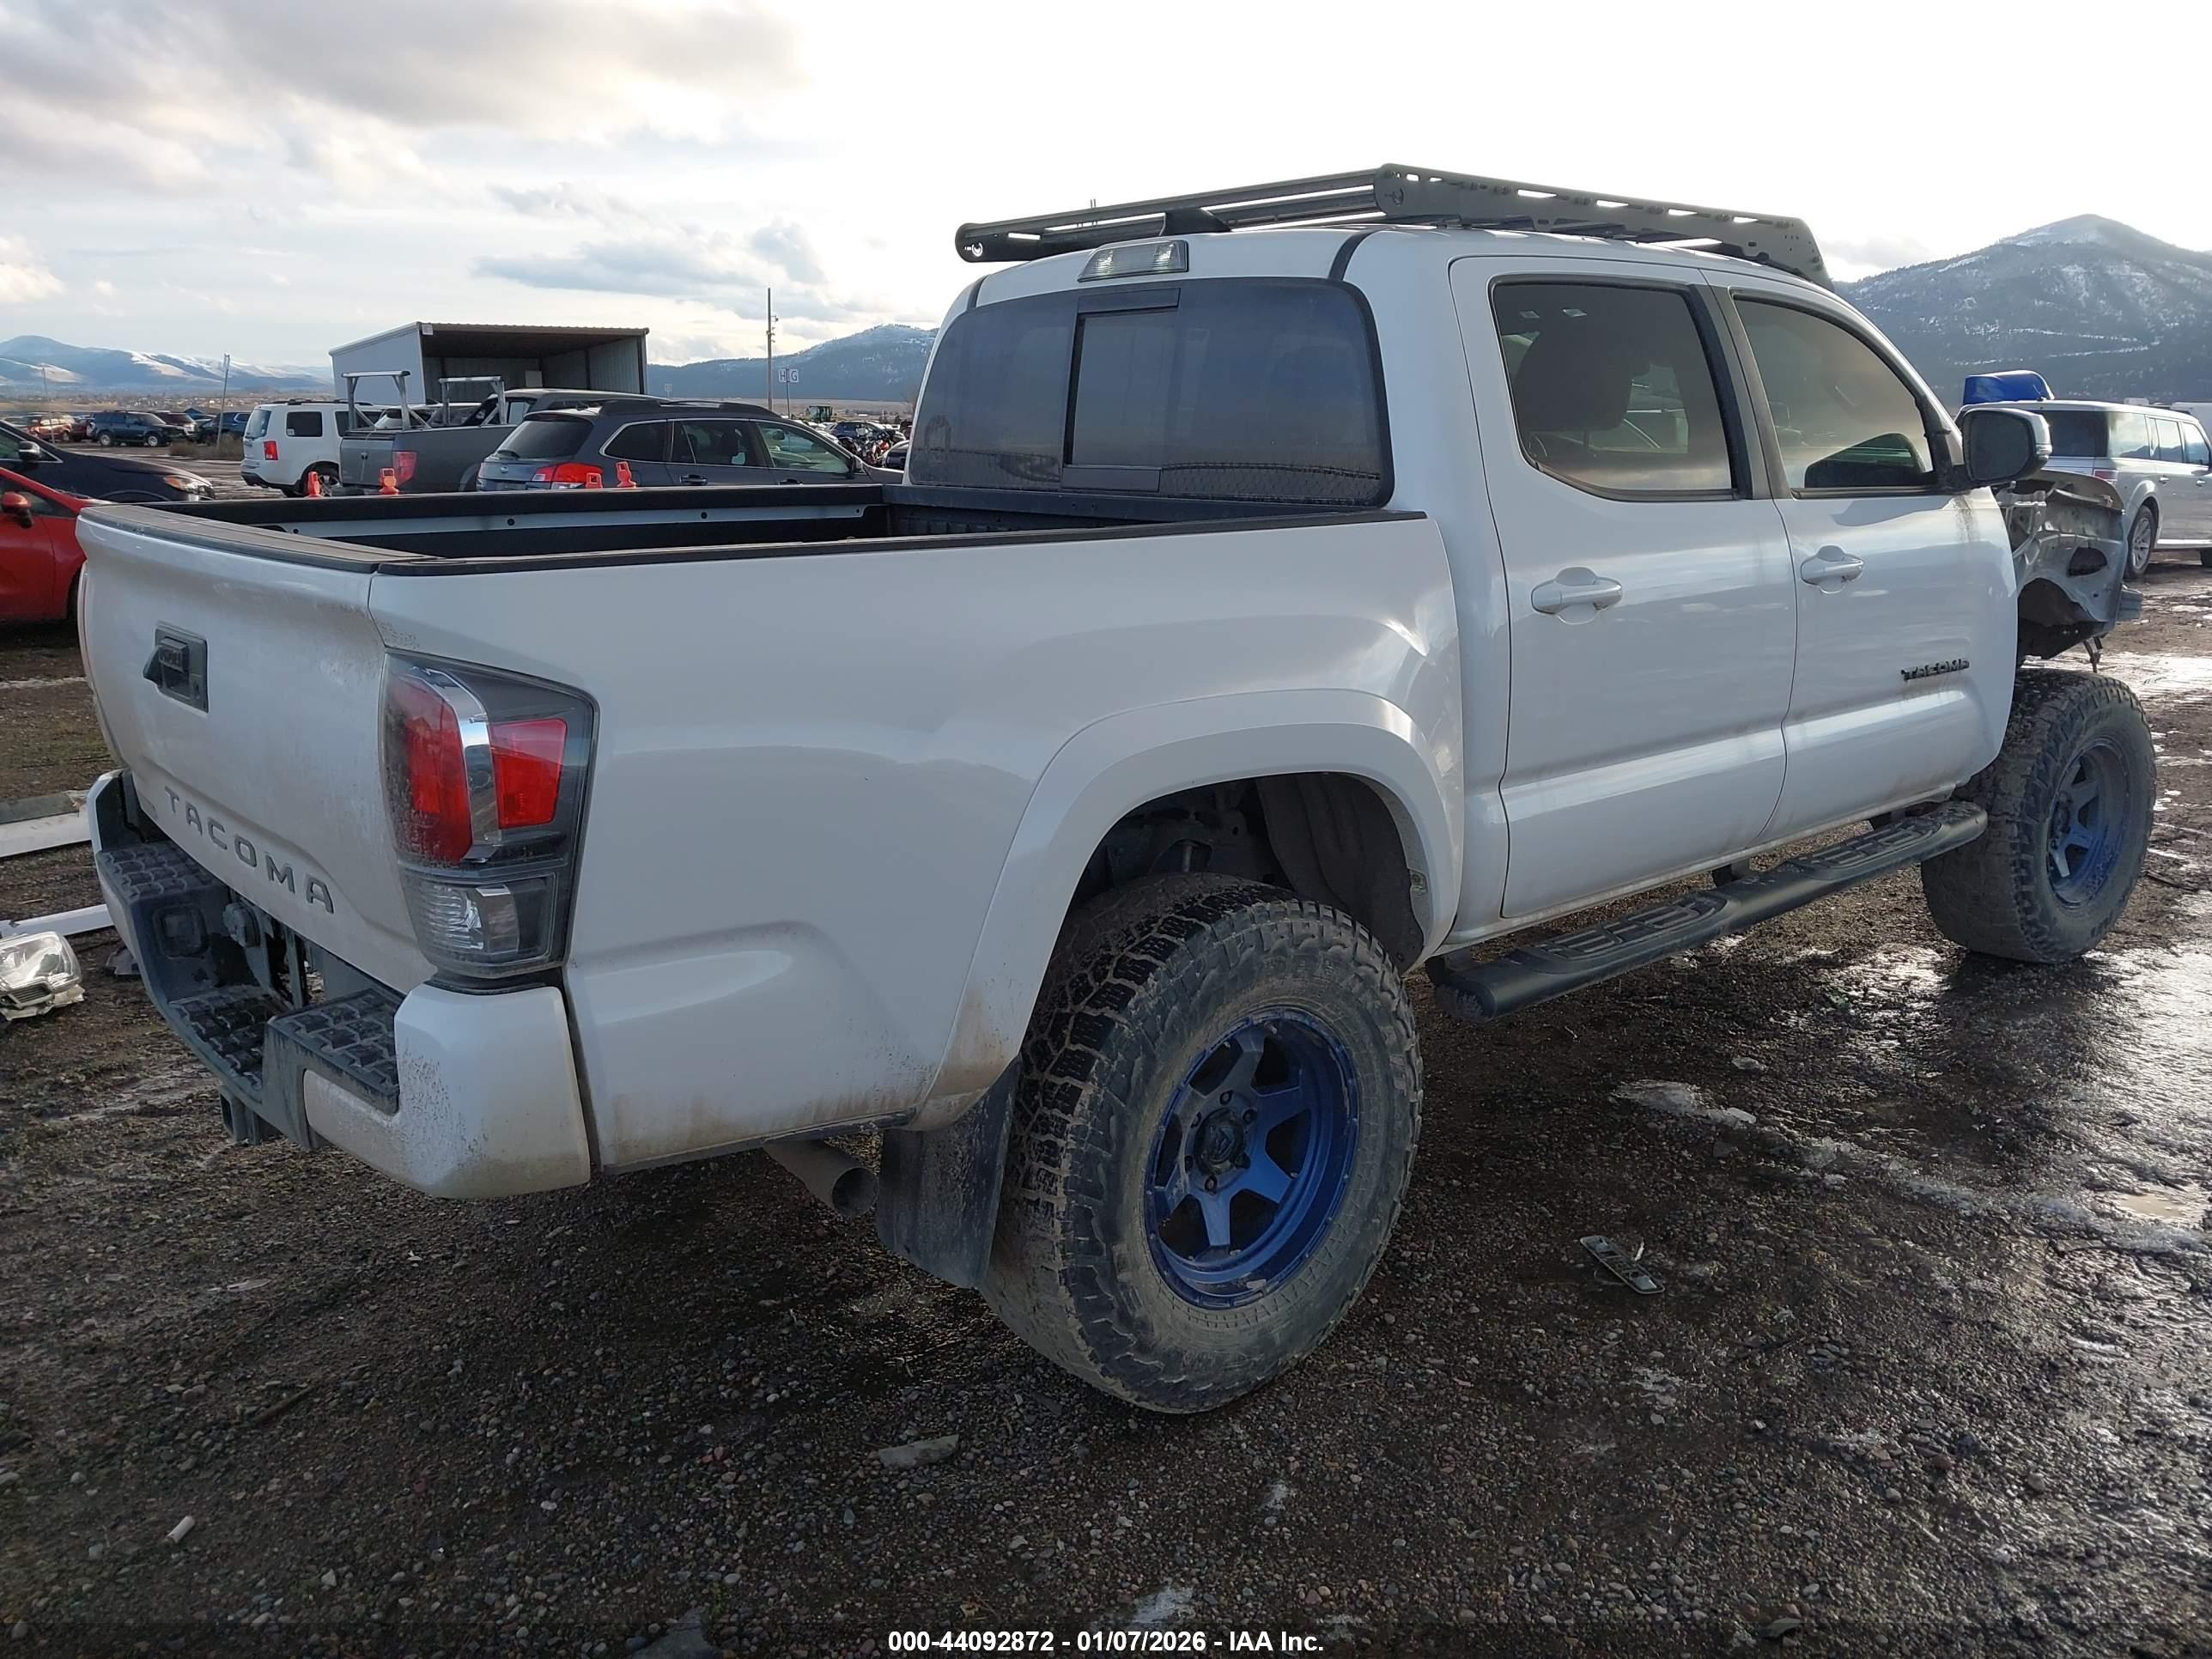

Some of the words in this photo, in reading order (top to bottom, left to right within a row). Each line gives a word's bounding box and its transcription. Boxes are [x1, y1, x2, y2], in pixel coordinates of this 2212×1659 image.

[791, 370, 798, 381] G
[1900, 659, 1970, 681] TACOMA
[164, 785, 335, 915] TACOMA
